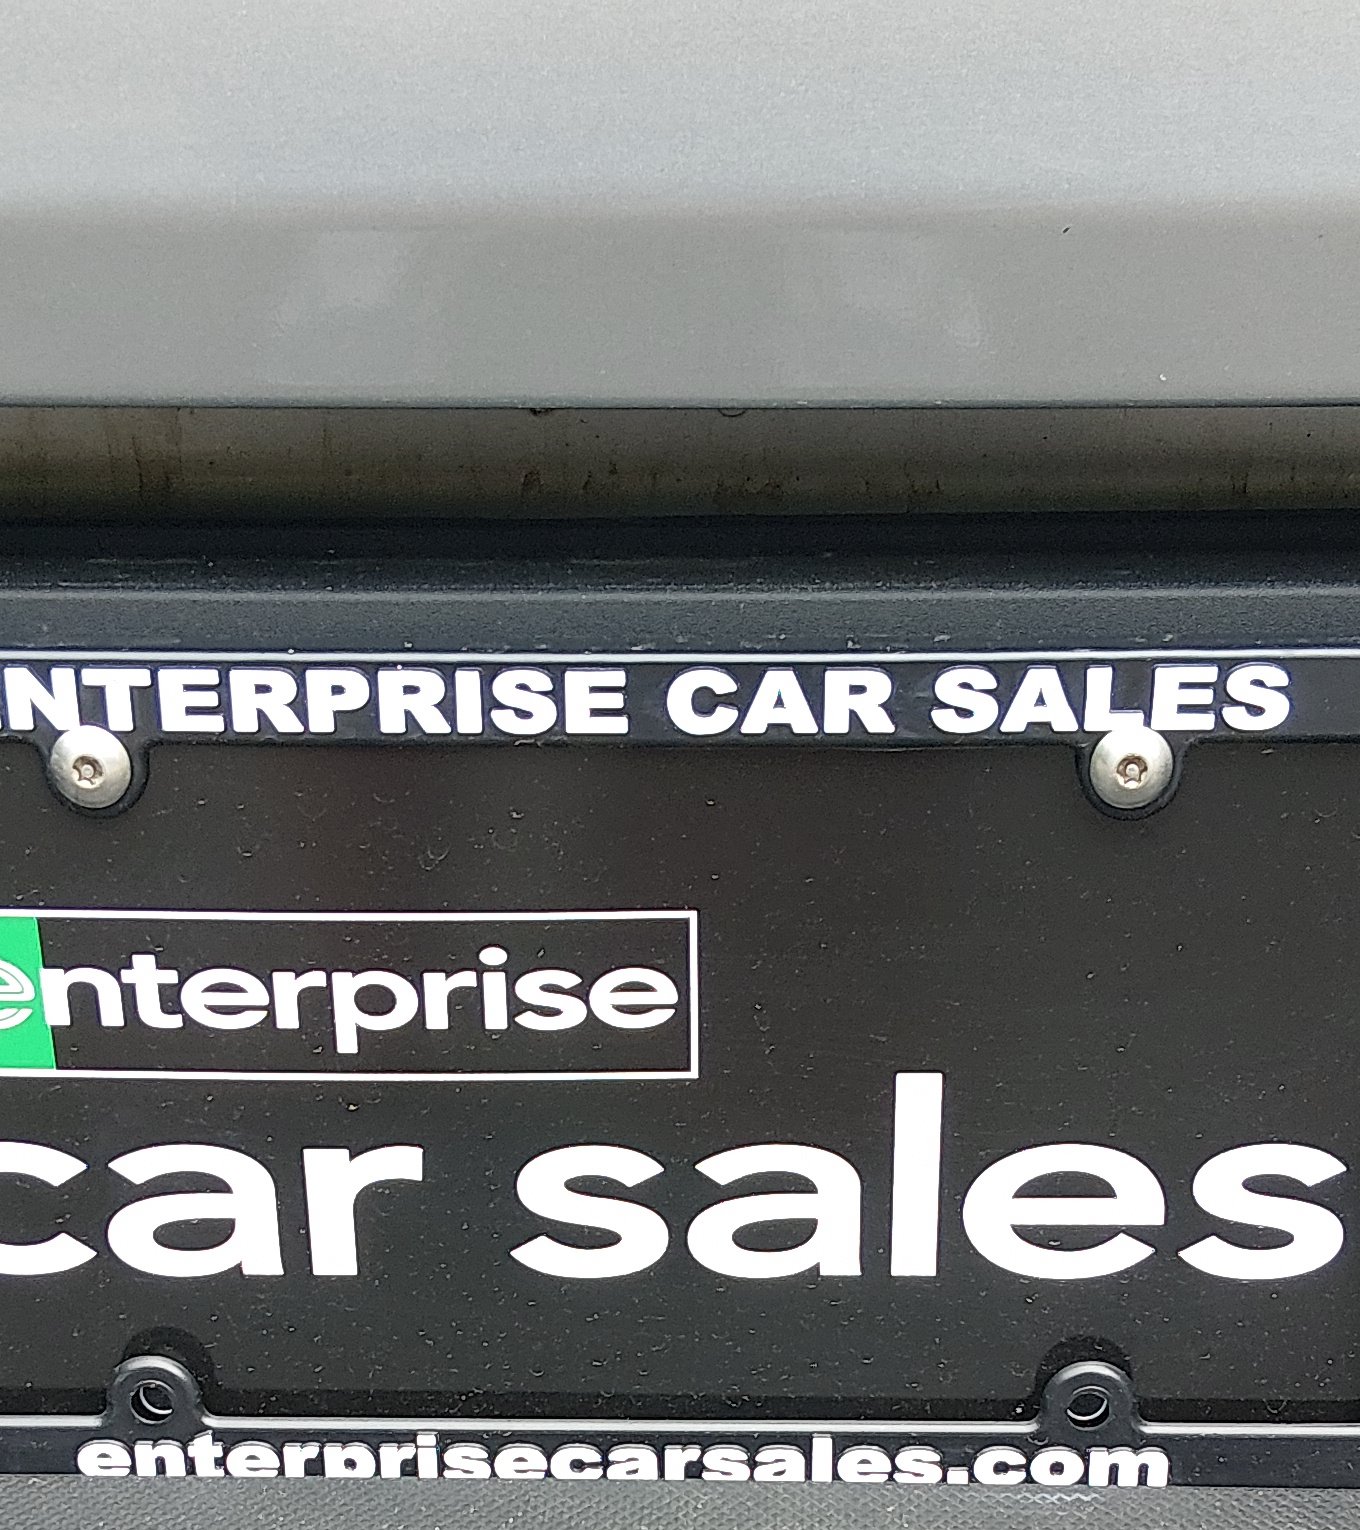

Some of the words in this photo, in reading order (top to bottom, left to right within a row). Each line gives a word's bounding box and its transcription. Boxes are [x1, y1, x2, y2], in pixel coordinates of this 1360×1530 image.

[666, 665, 897, 736] CAR
[930, 662, 1293, 735] SALES
[508, 1070, 1350, 1280] sales
[76, 1430, 1171, 1488] enterprisecarsales.com
